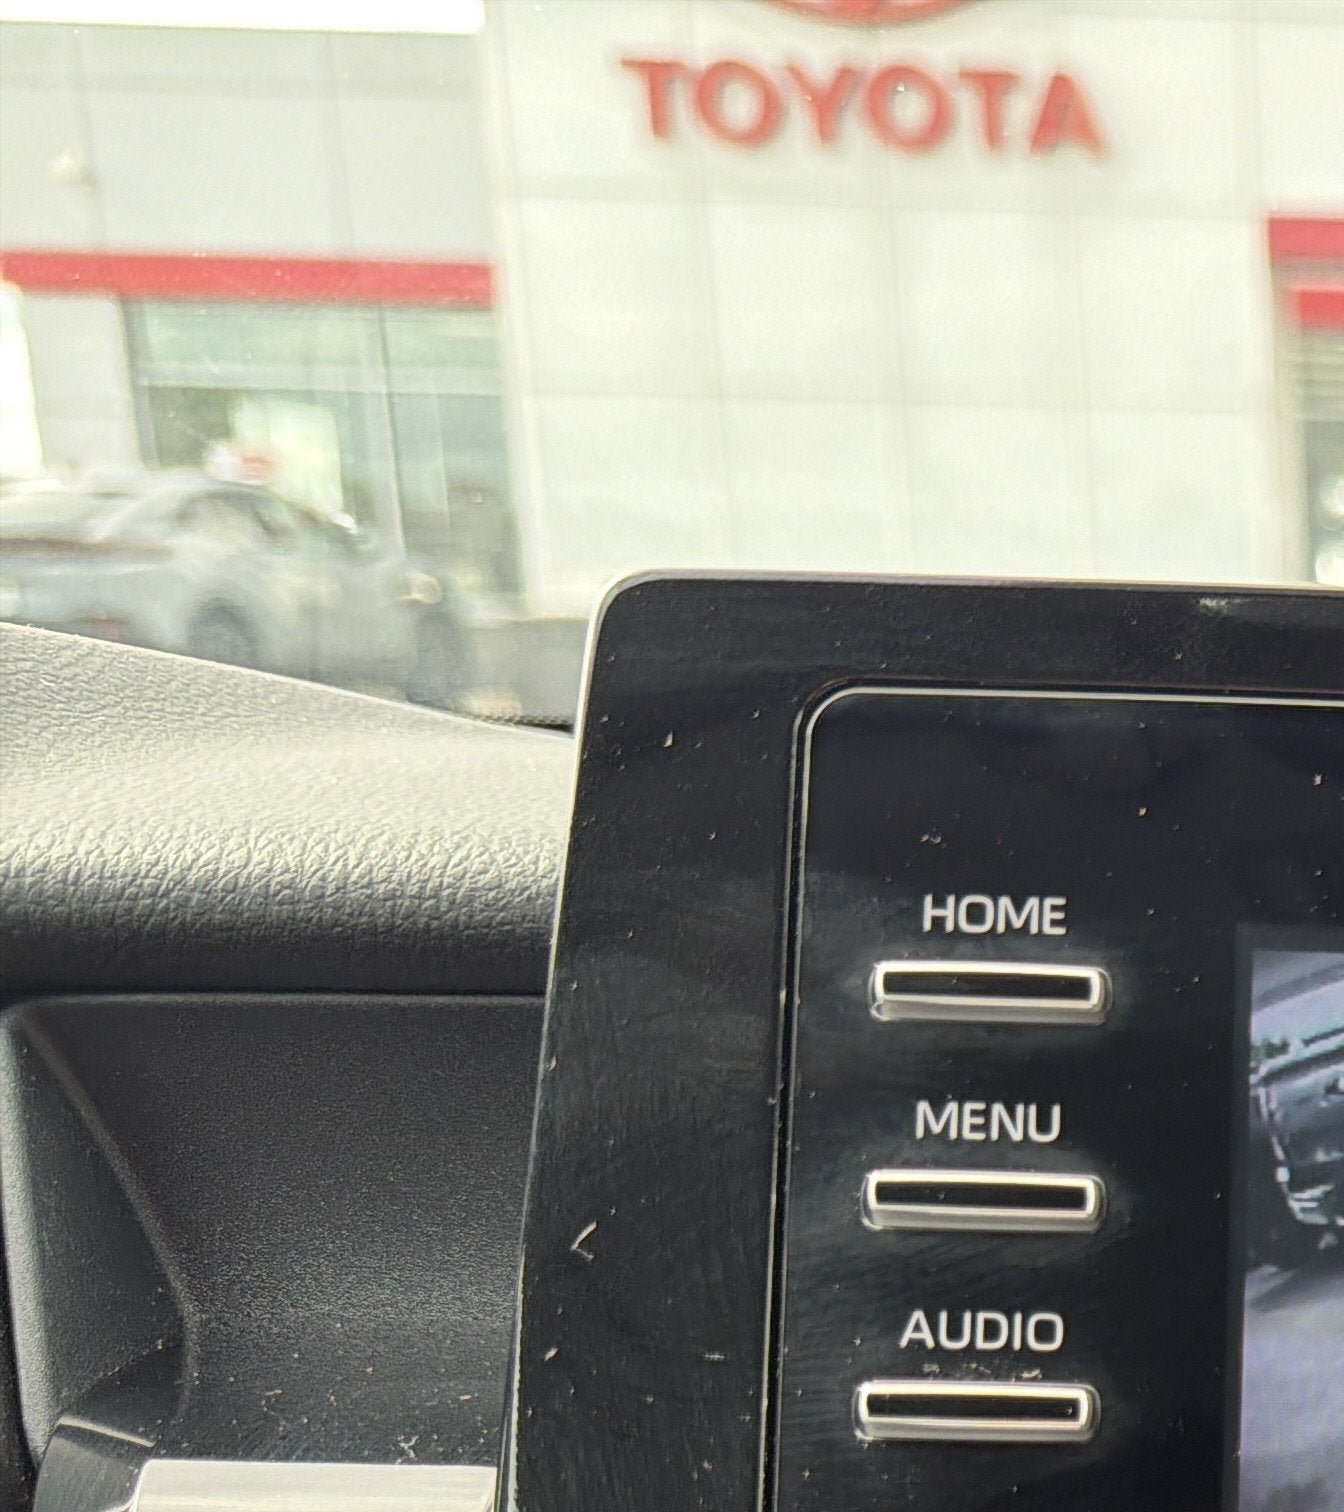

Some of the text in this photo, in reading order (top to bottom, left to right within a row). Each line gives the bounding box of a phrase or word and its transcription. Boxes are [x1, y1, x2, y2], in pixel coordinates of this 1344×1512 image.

[618, 56, 1110, 160] TOYOTA
[922, 894, 1067, 936] HOME
[915, 1100, 1061, 1143] MENU
[899, 1309, 1065, 1352] AUDIO
